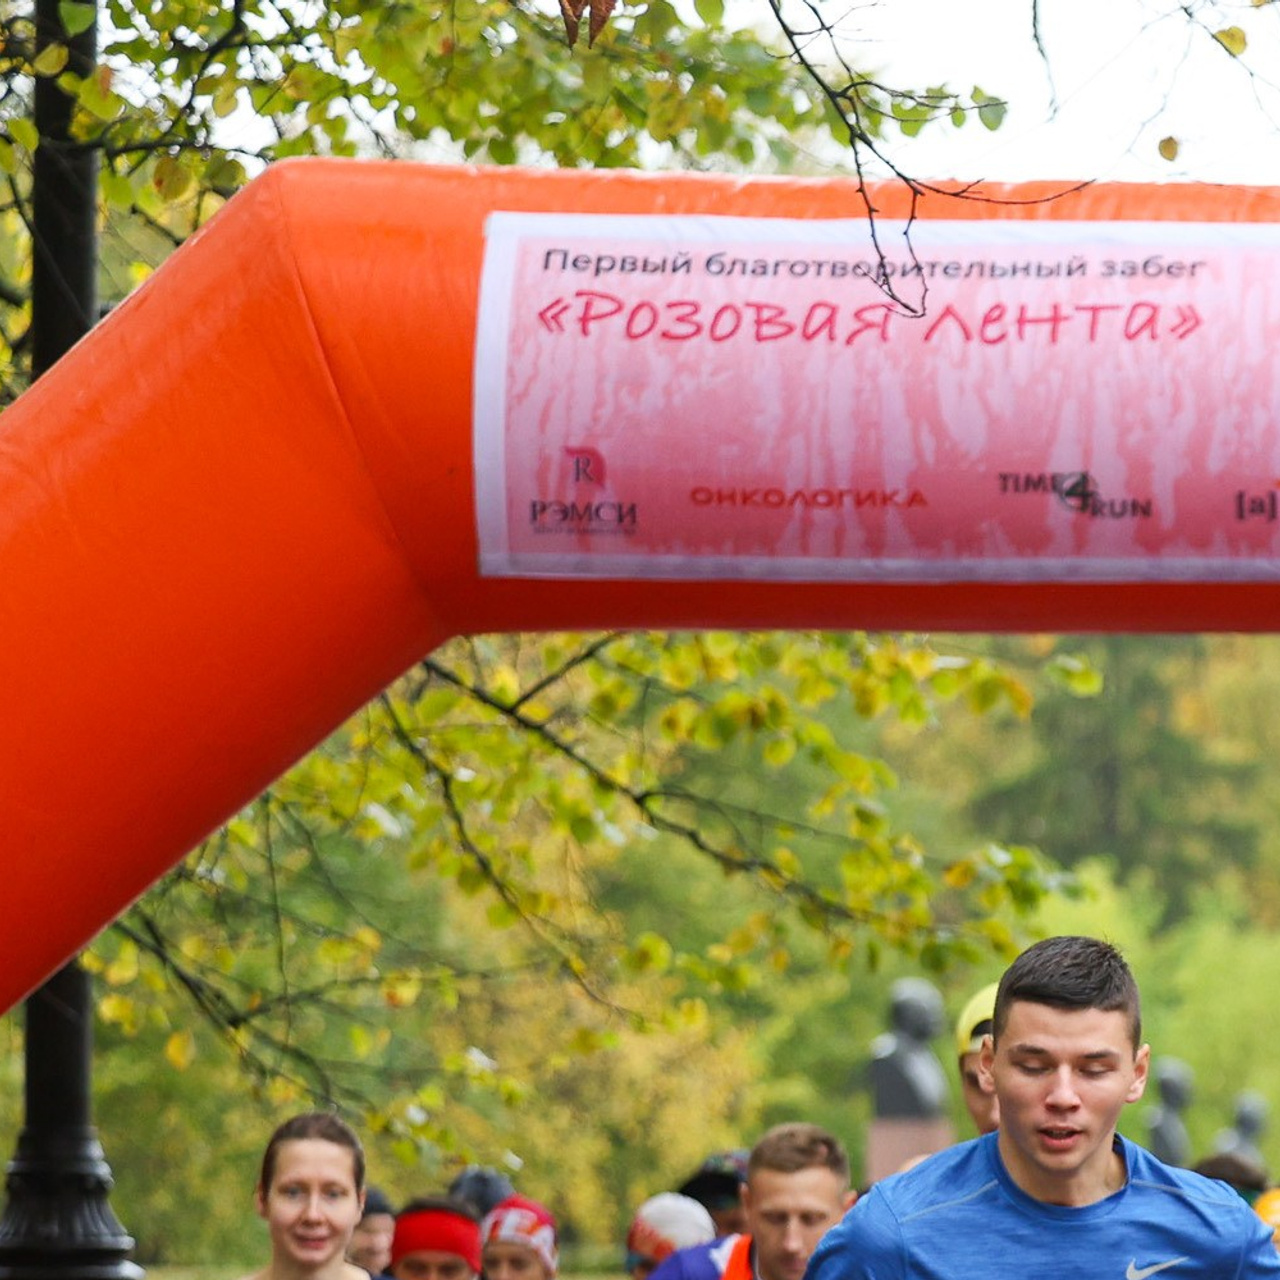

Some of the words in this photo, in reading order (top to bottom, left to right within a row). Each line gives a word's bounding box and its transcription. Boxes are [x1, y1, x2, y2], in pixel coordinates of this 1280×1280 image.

[543, 248, 692, 276] Первый
[705, 251, 1087, 281] благотворительный
[1100, 254, 1206, 278] забег
[689, 486, 930, 511] ОНКОЛОГИКА
[530, 499, 638, 526] РЭМСИ
